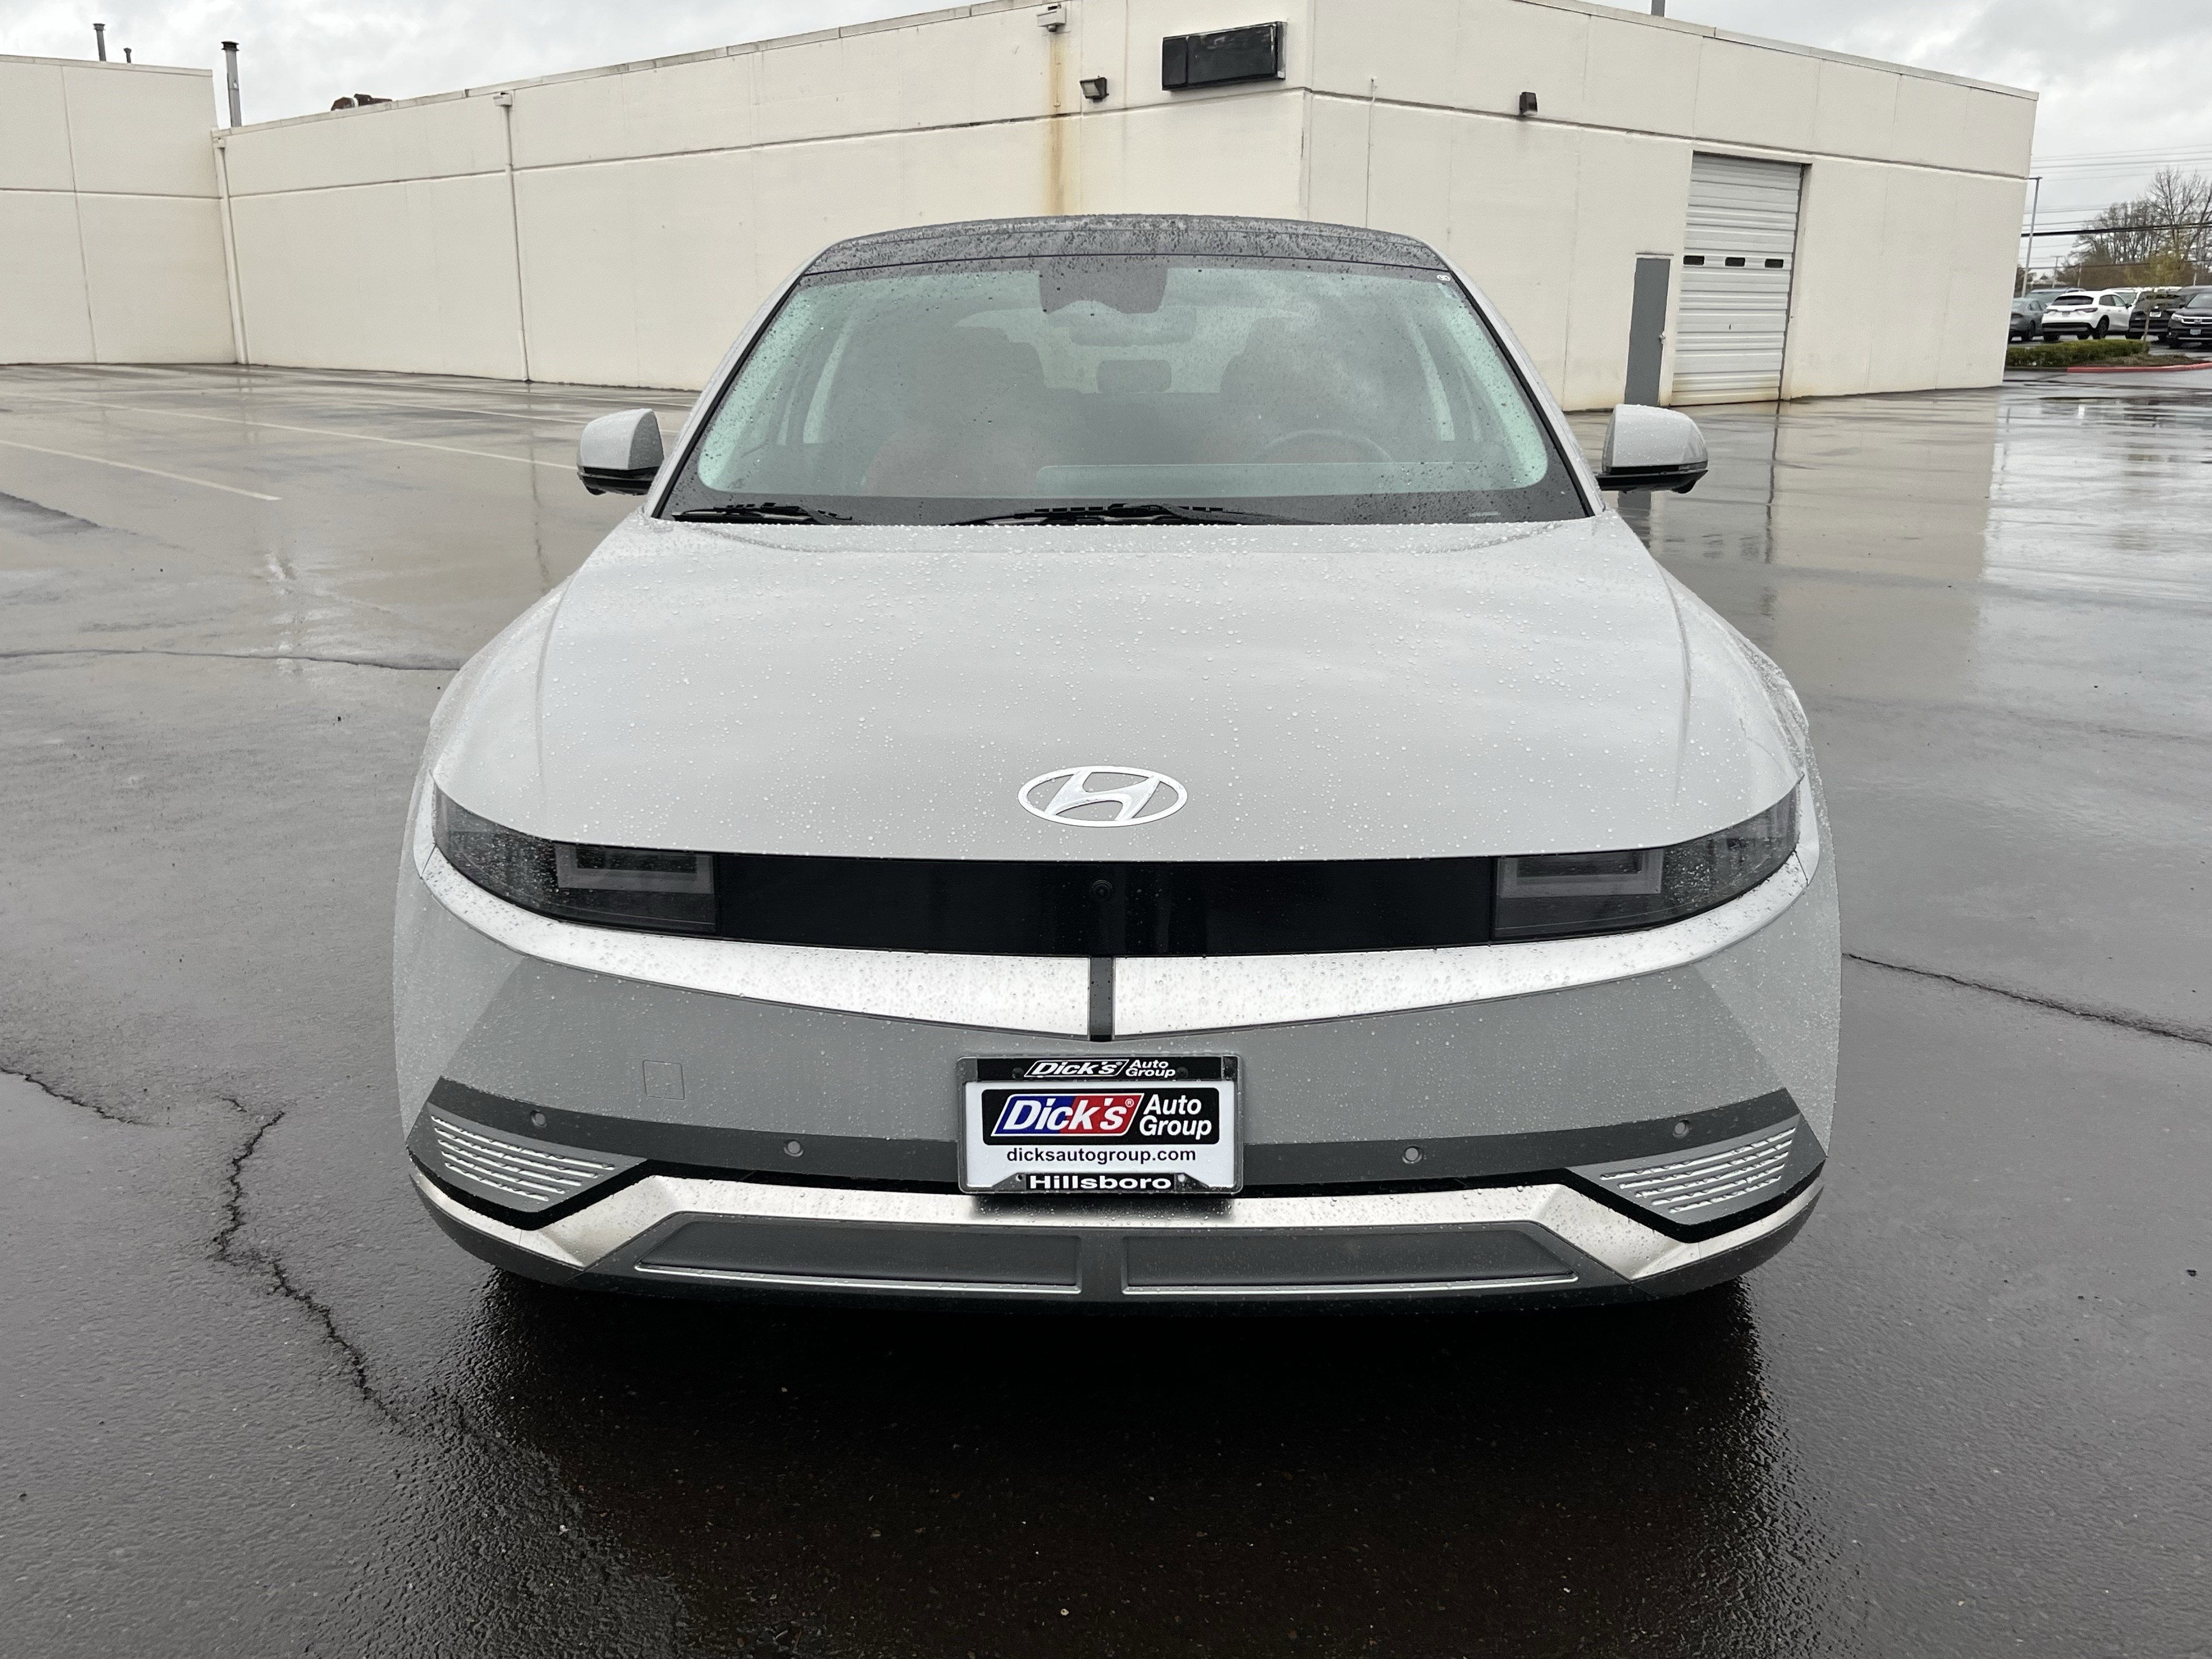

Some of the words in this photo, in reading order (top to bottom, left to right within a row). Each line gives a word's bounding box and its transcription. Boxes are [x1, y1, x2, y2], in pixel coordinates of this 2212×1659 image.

[1031, 1062, 1118, 1075] Dick's
[1129, 1059, 1169, 1069] Auto
[1125, 1068, 1176, 1078] Group
[1143, 1094, 1202, 1115] Auto
[1003, 1098, 1127, 1130] Dick's
[1139, 1115, 1212, 1140] Group
[1007, 1148, 1196, 1165] dicksautogroup.com
[1029, 1175, 1172, 1189] Hillsboro
